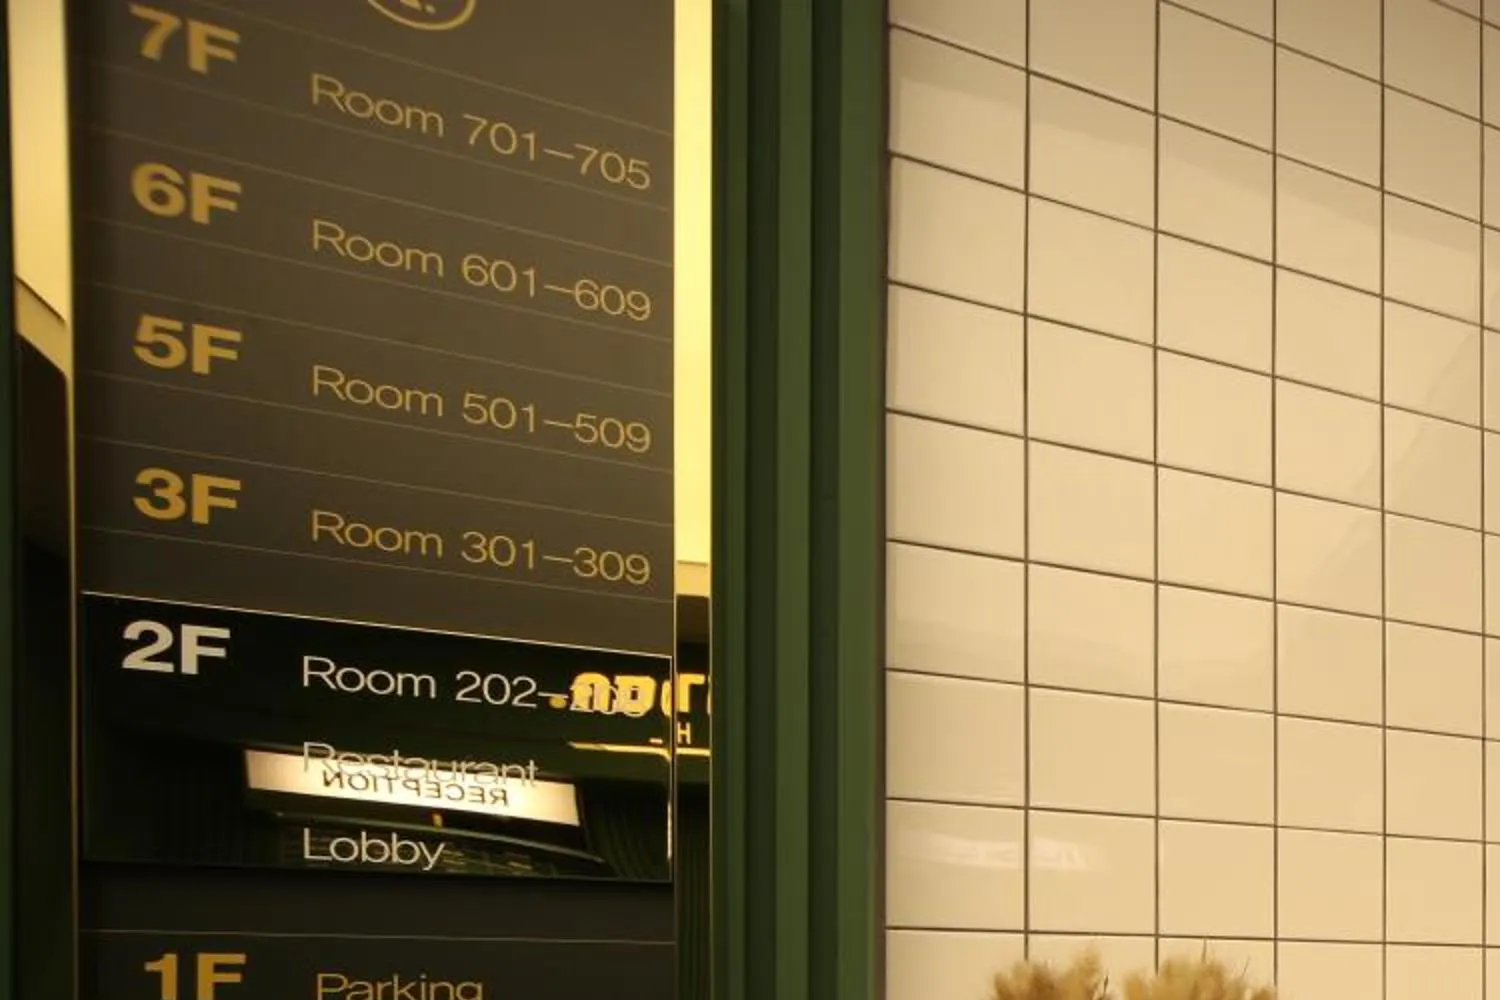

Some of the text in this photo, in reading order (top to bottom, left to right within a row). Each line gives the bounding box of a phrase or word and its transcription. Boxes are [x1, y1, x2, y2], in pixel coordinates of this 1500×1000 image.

[129, 5, 239, 72] 7F
[312, 74, 443, 136] Room
[132, 164, 240, 224] 6F
[313, 220, 443, 276] Room
[133, 315, 241, 373] 5F
[314, 365, 442, 416] Room
[133, 469, 240, 524] 3F
[313, 510, 442, 556] Room
[123, 621, 230, 674] 2F
[304, 656, 435, 698] Room
[303, 741, 538, 788] Restaurant
[303, 828, 445, 871] Lobby
